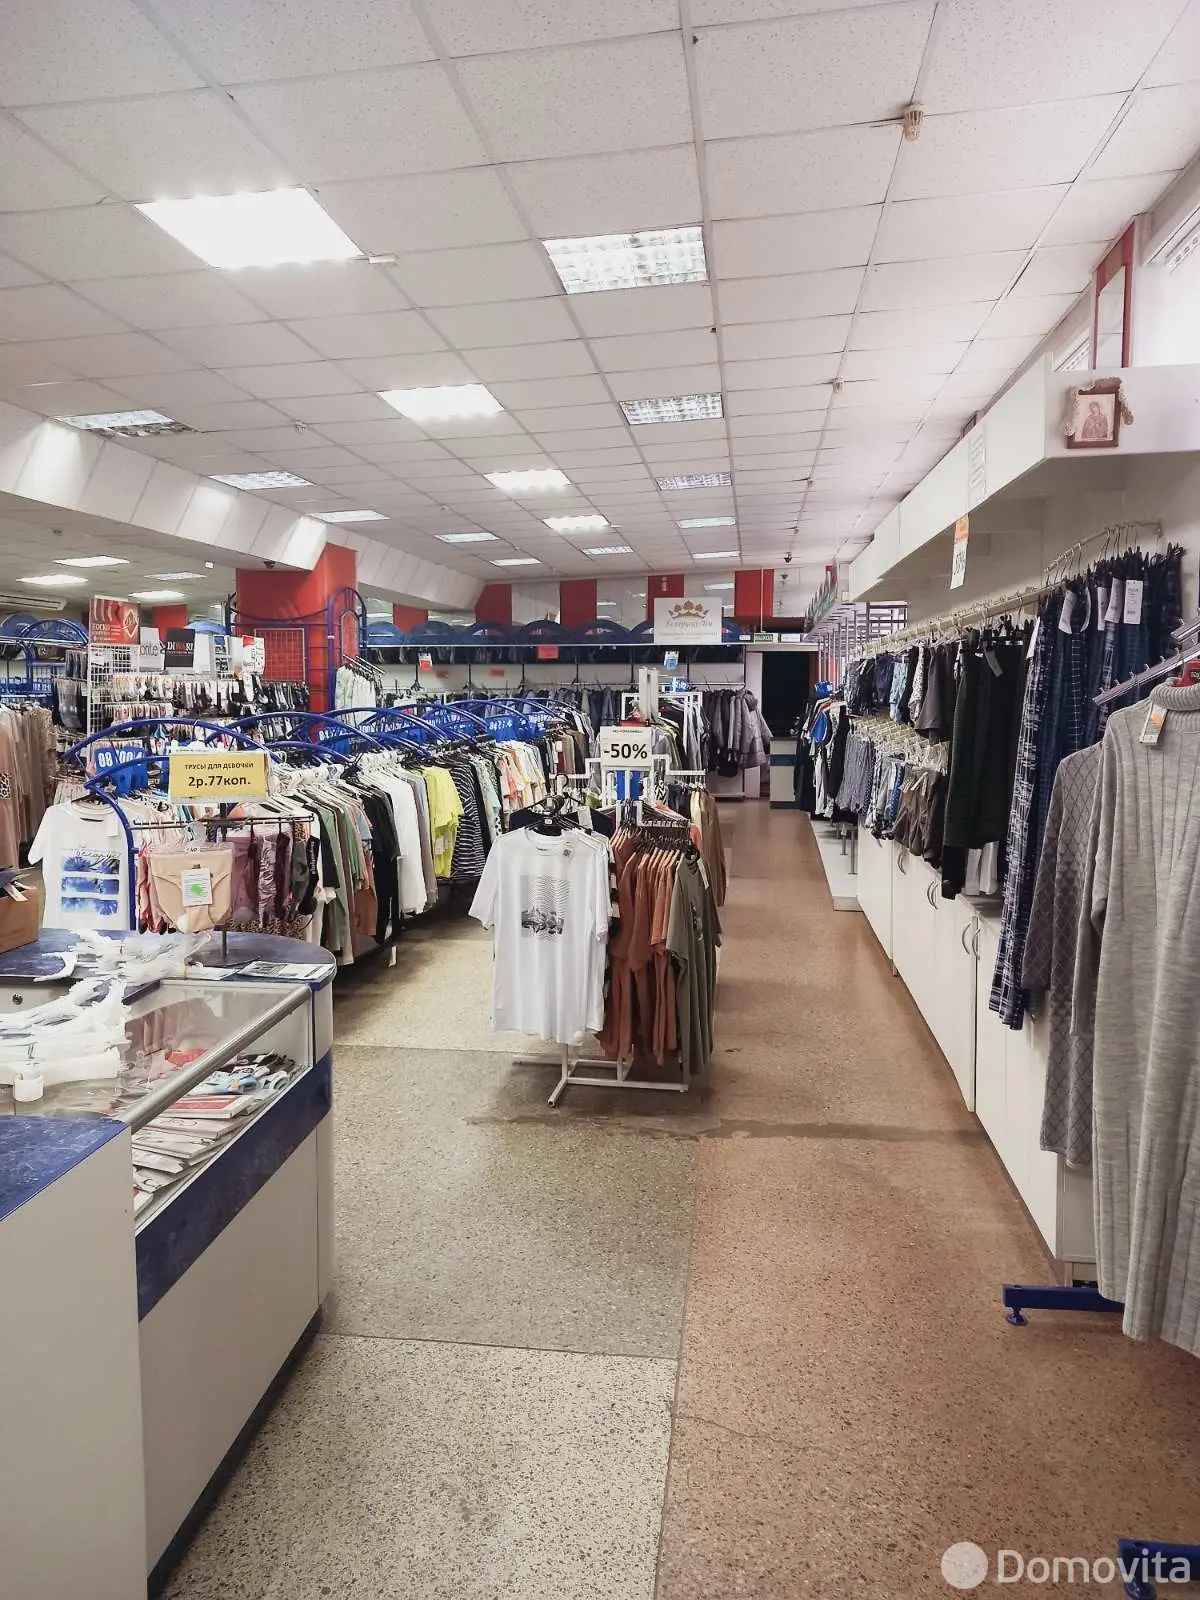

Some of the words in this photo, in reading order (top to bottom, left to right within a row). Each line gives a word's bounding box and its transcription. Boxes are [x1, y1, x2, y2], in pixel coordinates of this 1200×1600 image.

[603, 743, 648, 759] -50%
[223, 762, 254, 770] ДЕВОЧКИ
[188, 775, 251, 788] 2р.77коп.
